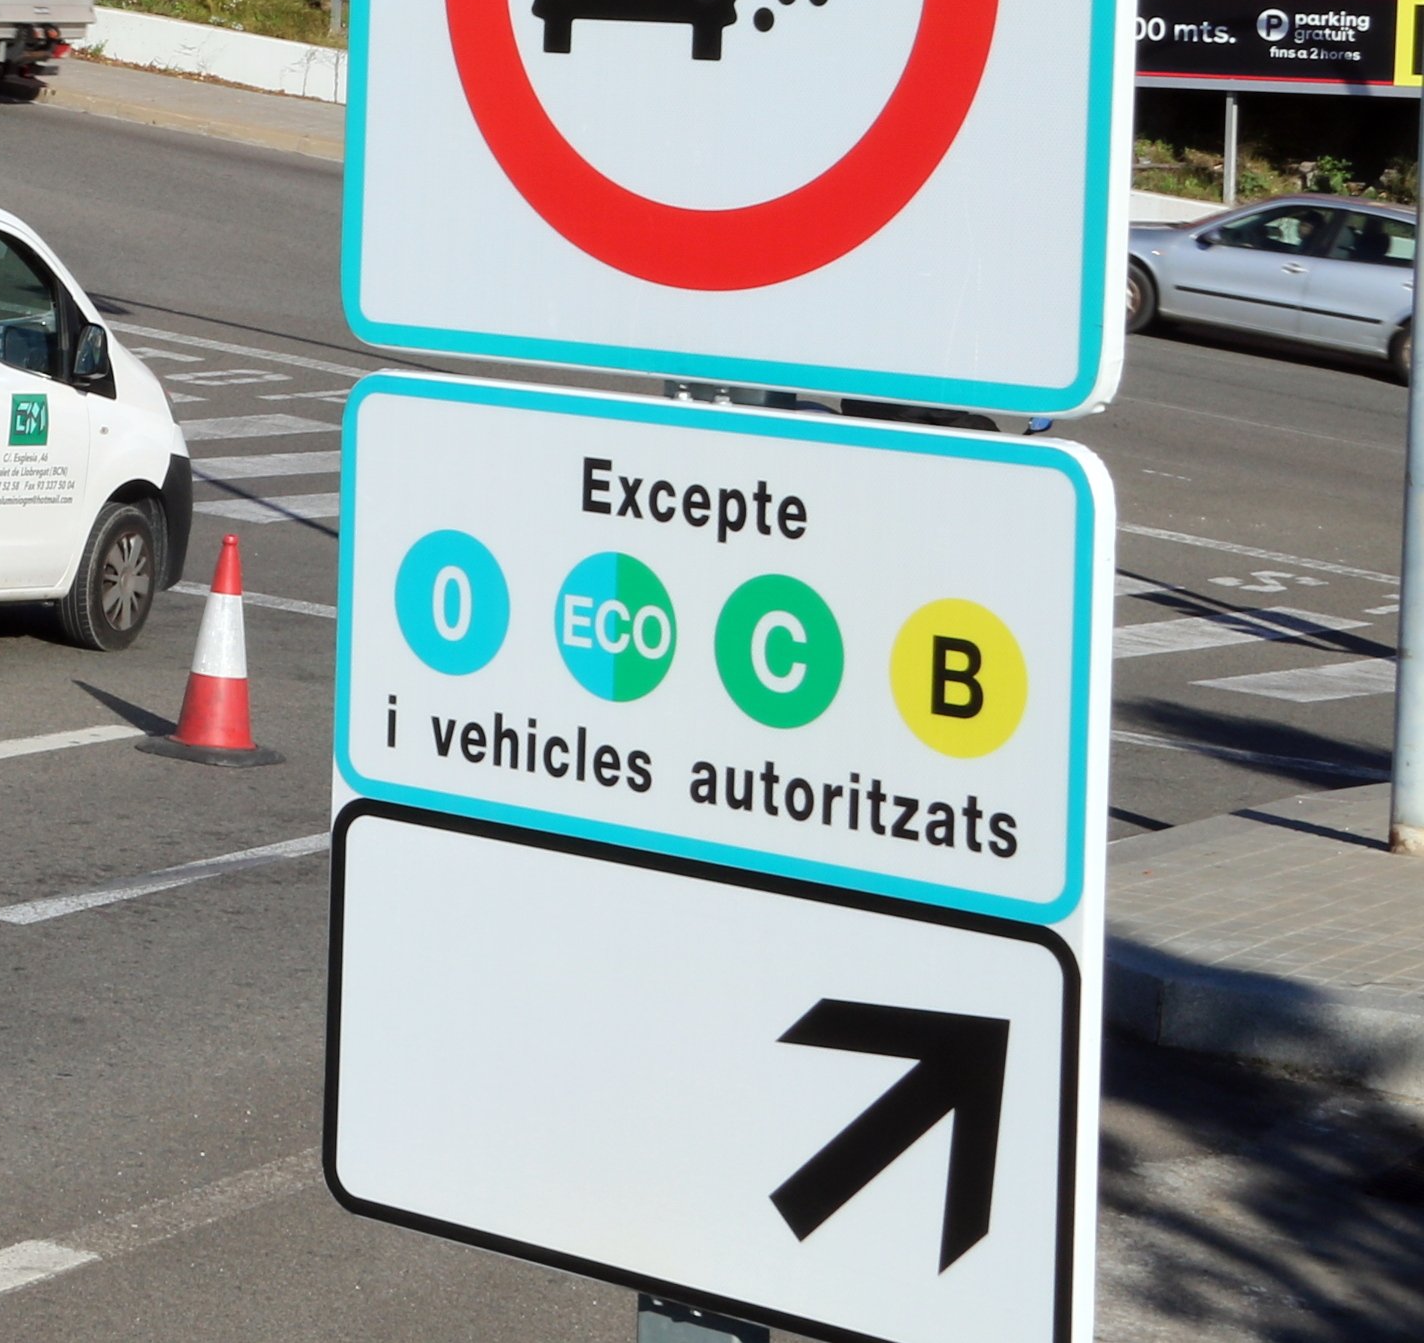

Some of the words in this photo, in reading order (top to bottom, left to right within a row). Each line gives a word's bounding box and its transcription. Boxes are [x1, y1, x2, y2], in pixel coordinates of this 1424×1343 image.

[1294, 11, 1370, 31] parking
[1174, 21, 1237, 44] mts.
[1294, 26, 1356, 43] gratuït
[1269, 46, 1296, 59] fins
[1297, 49, 1308, 59] a
[1309, 47, 1319, 60] 2
[1320, 47, 1361, 61] hores
[13, 452, 37, 464] Esglesia
[11, 467, 19, 477] de
[582, 456, 808, 543] Excepte
[562, 595, 671, 660] ECO
[751, 610, 807, 693] C
[930, 636, 985, 720] B
[385, 695, 398, 748] i
[432, 712, 653, 793] vehicles
[690, 759, 1018, 859] autoritzats
